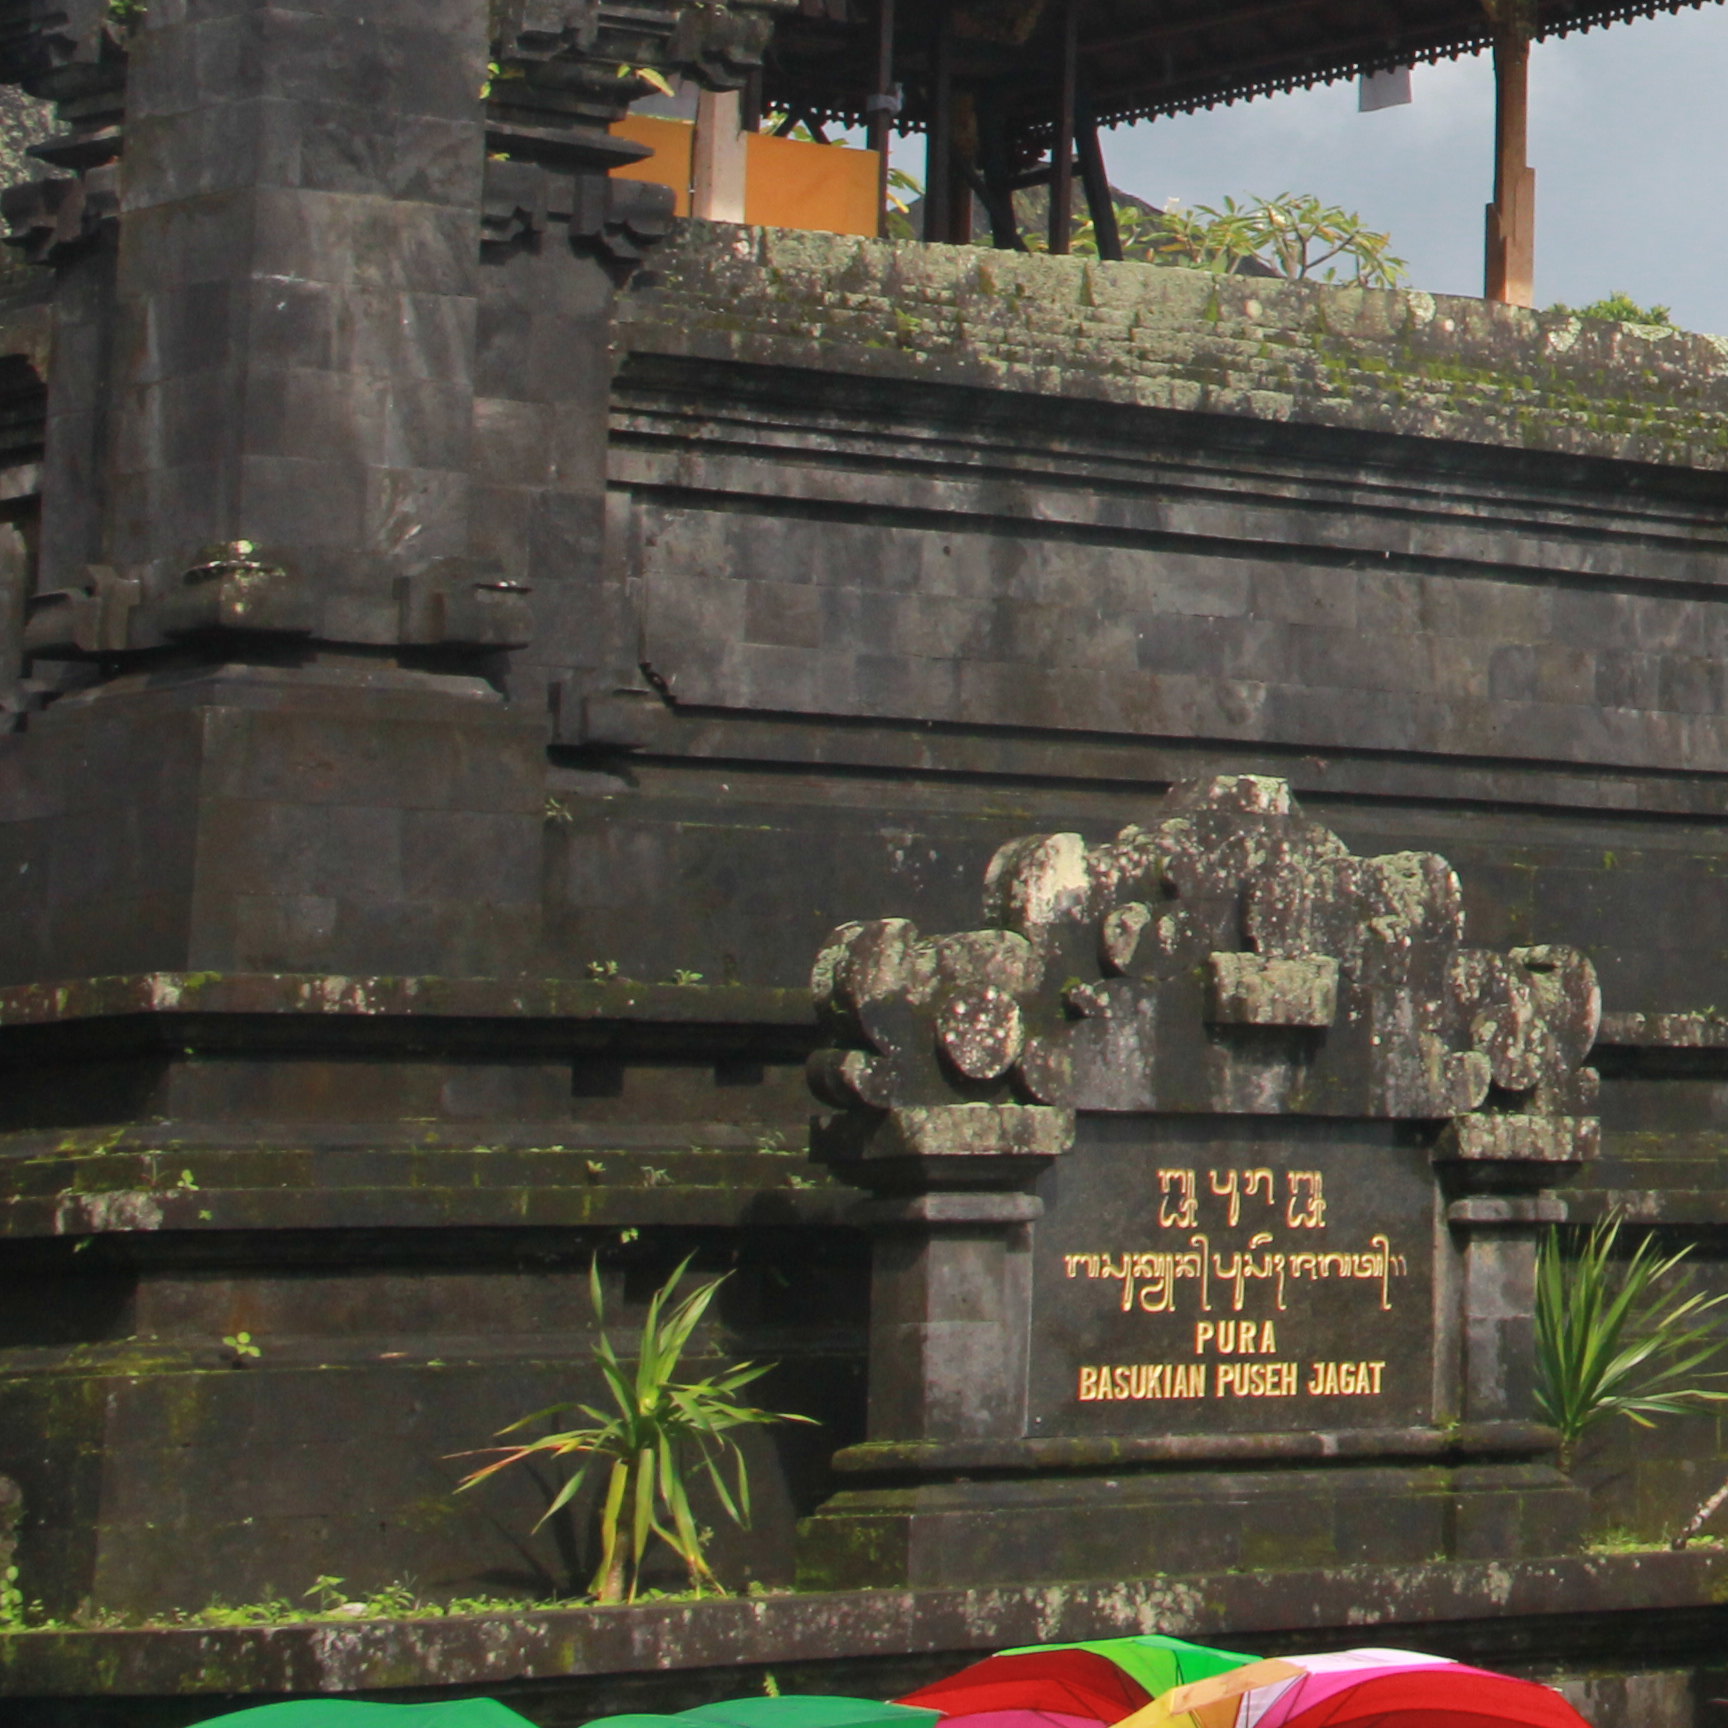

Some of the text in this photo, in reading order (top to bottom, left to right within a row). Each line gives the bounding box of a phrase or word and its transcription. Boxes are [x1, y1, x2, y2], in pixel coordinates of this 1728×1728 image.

[1194, 1319, 1277, 1355] PURA
[1078, 1360, 1386, 1402] BASUKIAN PUSEH JAGAT
